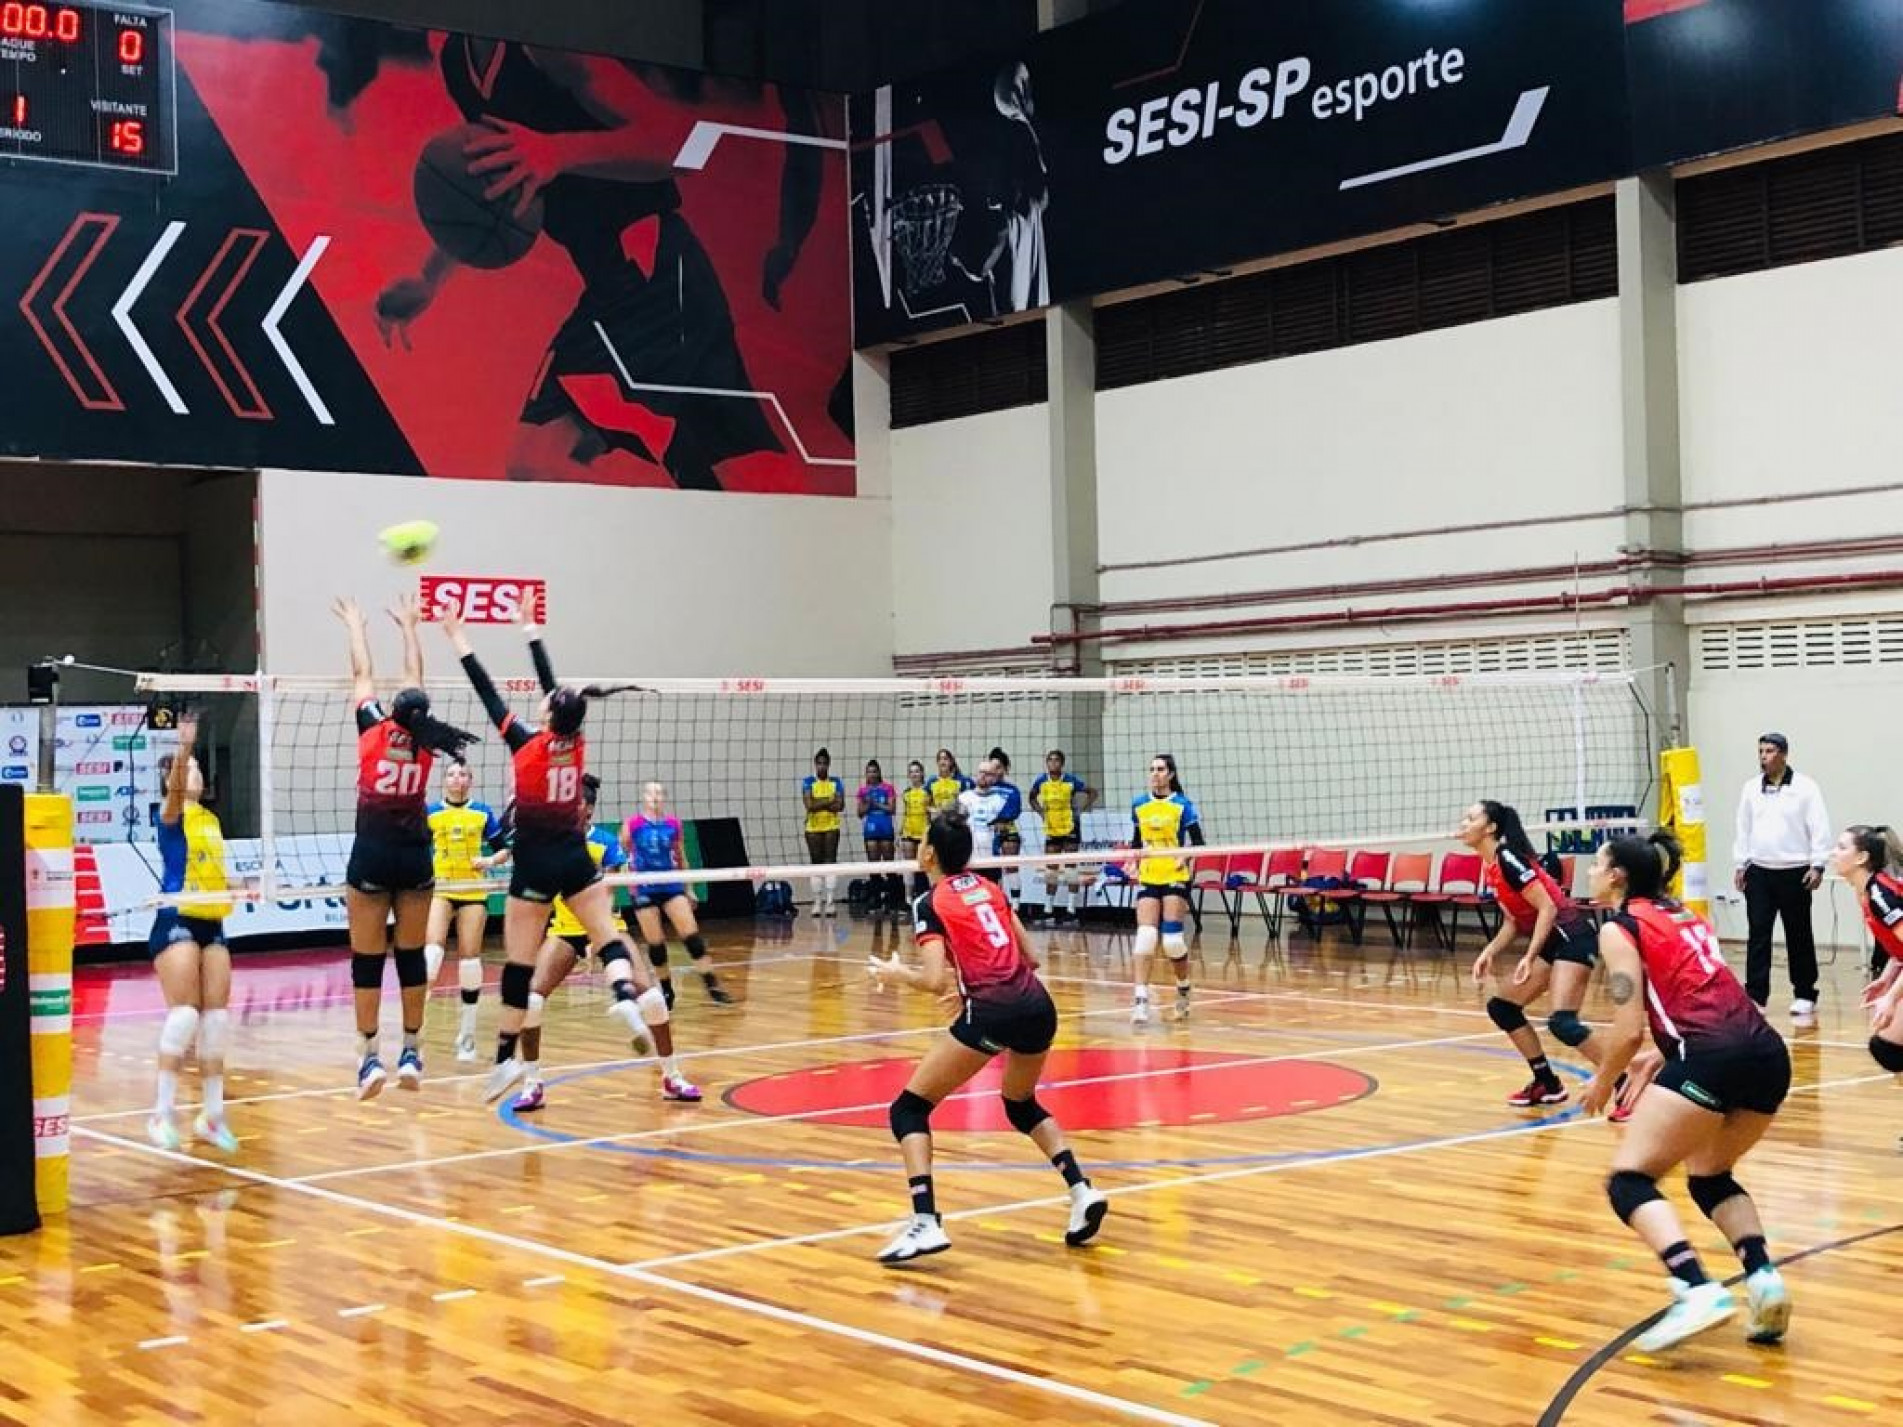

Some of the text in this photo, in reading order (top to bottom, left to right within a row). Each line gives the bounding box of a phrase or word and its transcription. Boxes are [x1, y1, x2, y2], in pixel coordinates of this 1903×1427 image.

[114, 14, 147, 28] FALTA
[119, 30, 141, 61] 0
[121, 64, 143, 75] SET
[16, 95, 25, 122] 1
[90, 99, 147, 116] VISITANTE
[1103, 47, 1465, 165] SESI-SP esporte
[112, 121, 143, 153] 15
[505, 679, 536, 691] SESI
[375, 759, 422, 795] 20
[547, 766, 578, 803] 18
[975, 903, 1010, 948] 9
